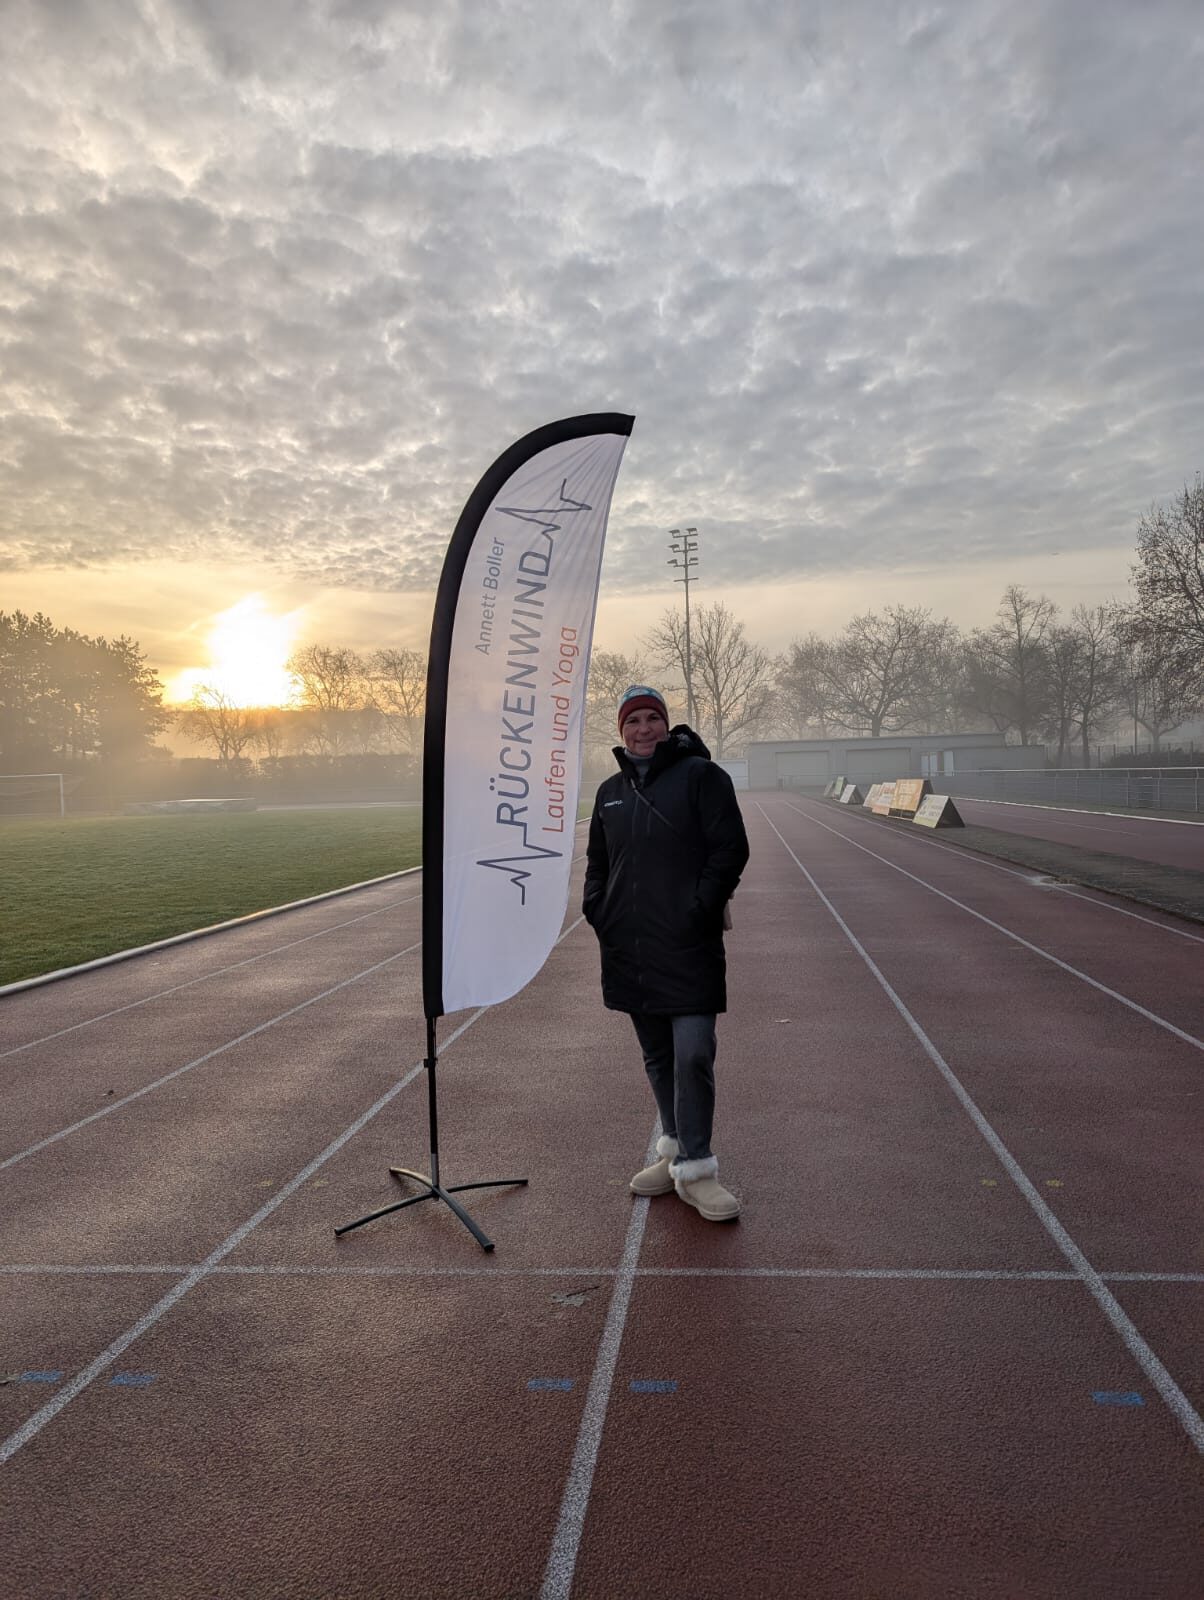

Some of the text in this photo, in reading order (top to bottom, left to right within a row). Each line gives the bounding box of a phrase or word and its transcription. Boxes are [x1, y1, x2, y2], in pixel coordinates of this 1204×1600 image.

[475, 537, 505, 655] Annett Boller
[489, 550, 550, 827] RÜCKENWIND
[542, 627, 580, 832] Laufen und Yoga
